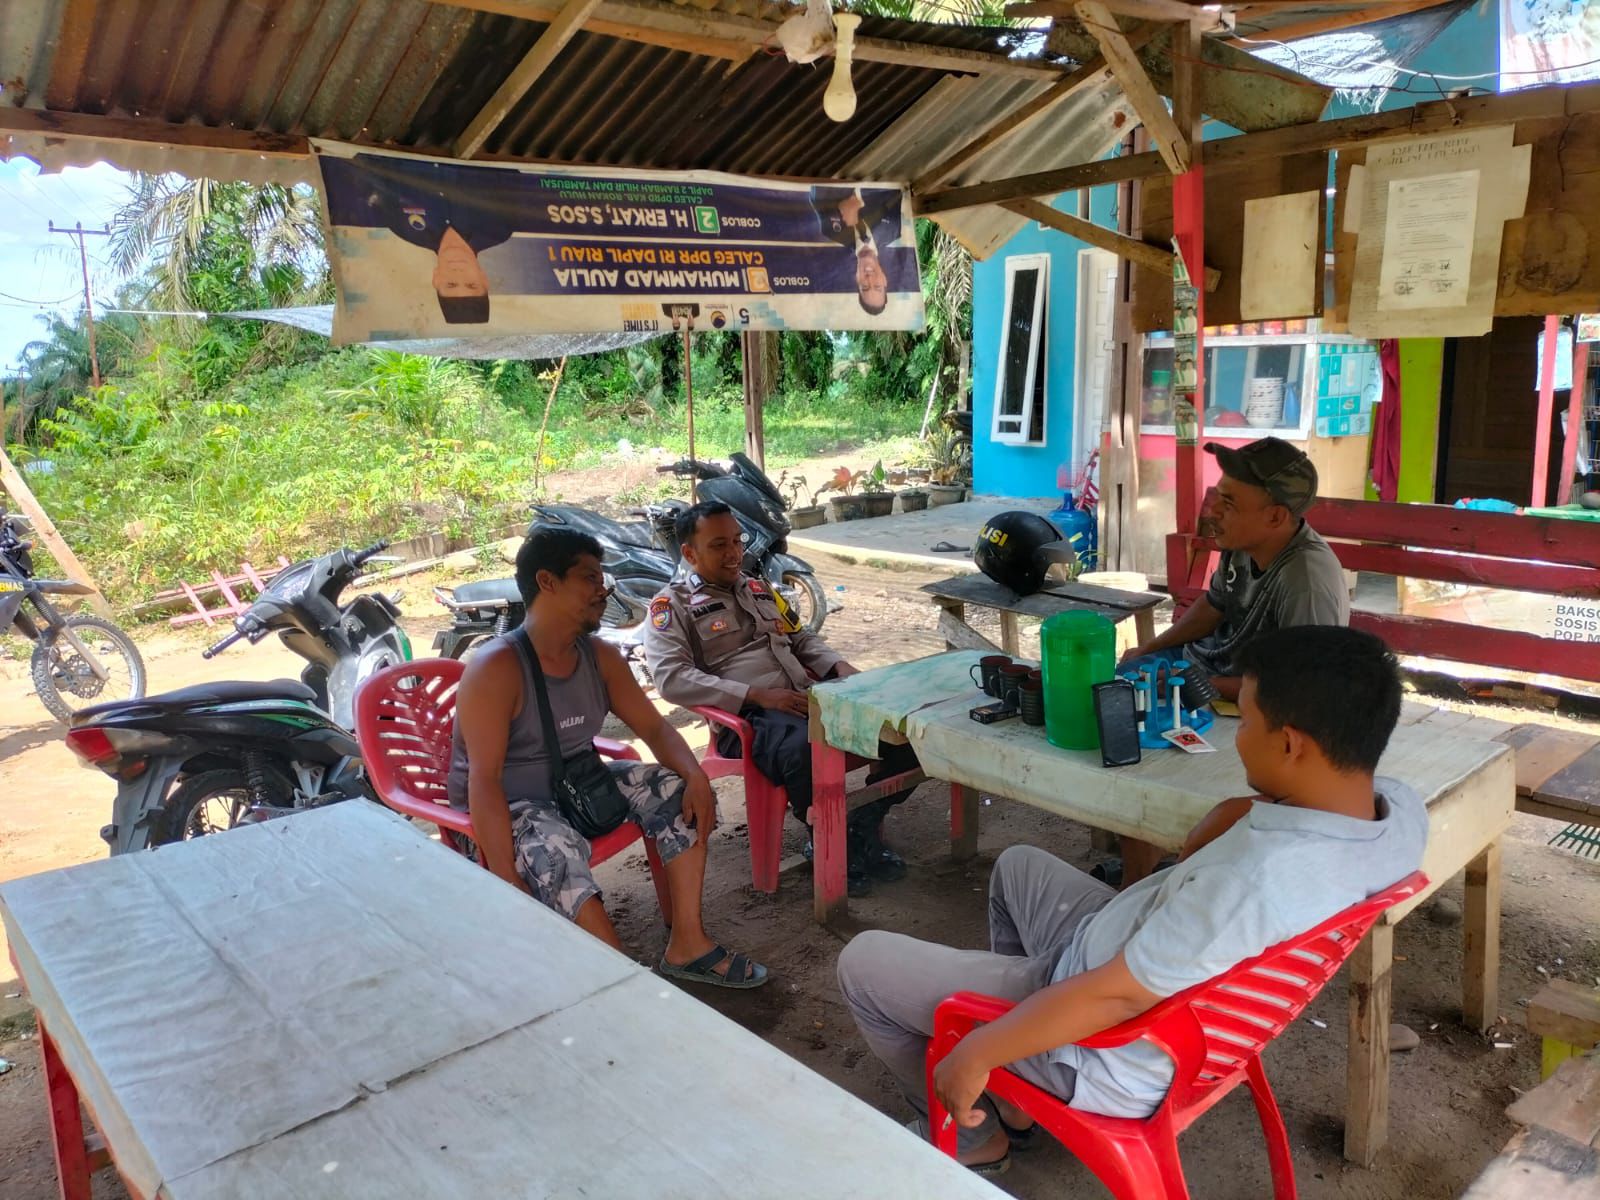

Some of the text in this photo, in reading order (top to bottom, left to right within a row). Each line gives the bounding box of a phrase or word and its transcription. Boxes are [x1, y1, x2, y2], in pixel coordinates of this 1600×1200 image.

[539, 178, 714, 196] DAPIL 2 RAMBAH HILIR DAN TAMBUSAI
[559, 190, 587, 200] HULU
[588, 191, 622, 201] ROKAN
[647, 194, 673, 203] DPRD
[674, 195, 703, 204] CALEG
[546, 203, 689, 228] H. ERKAT, S.SOS
[701, 211, 714, 229] 2
[721, 216, 761, 228] COBLOS
[547, 246, 764, 265] CALEG DPR RI DAPIL RIAU 1
[552, 268, 740, 288] MUHAMMAD AULIA
[773, 276, 810, 287] COBLOS
[739, 307, 750, 324] 5
[623, 319, 643, 332] TIME!
[1554, 617, 1598, 632] SOSIS
[1554, 629, 1583, 641] POP
